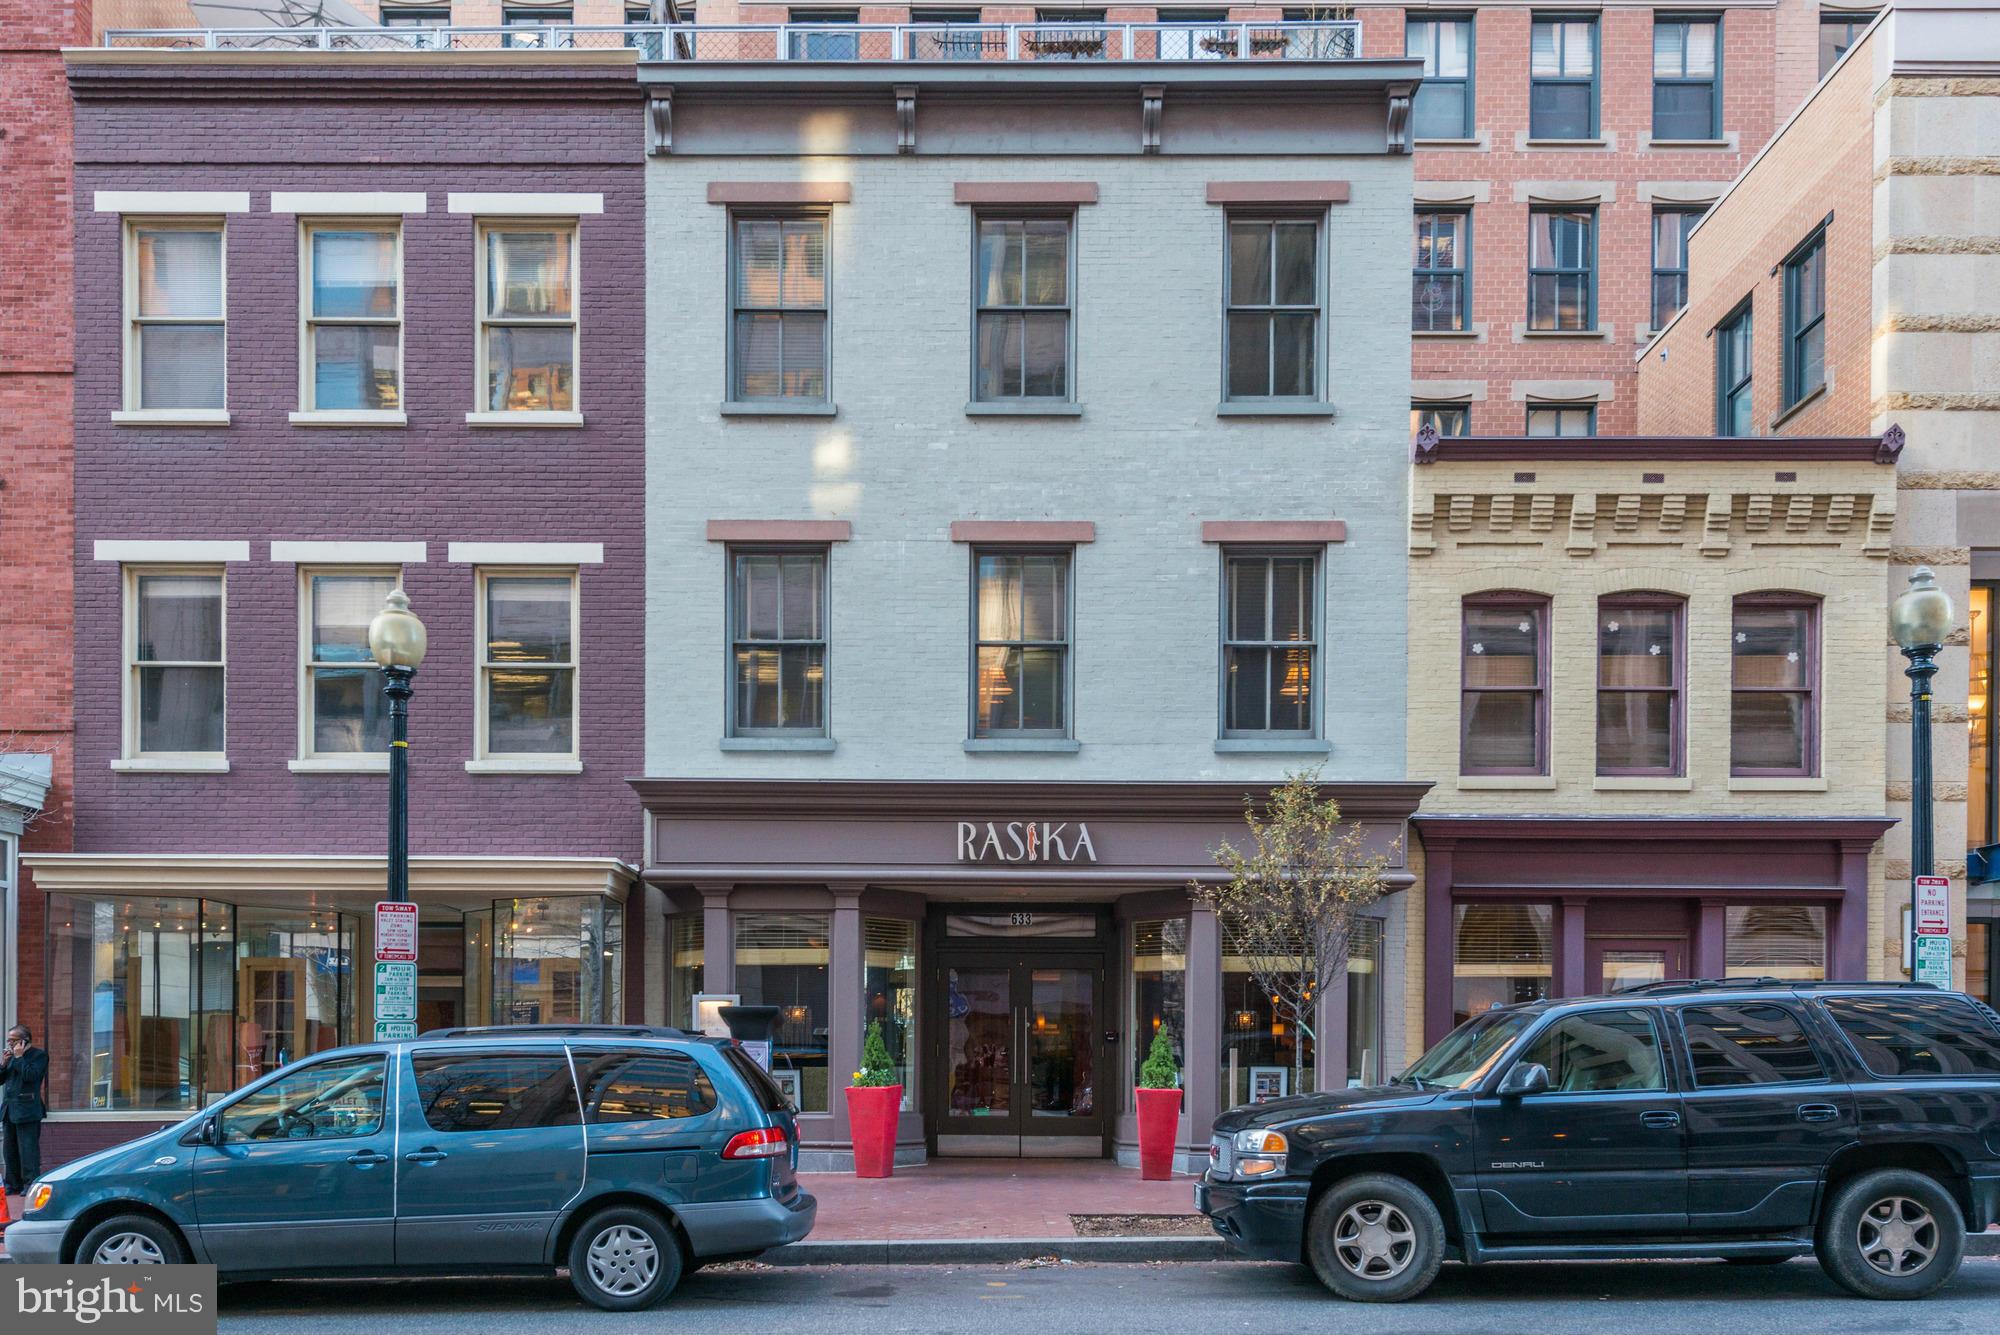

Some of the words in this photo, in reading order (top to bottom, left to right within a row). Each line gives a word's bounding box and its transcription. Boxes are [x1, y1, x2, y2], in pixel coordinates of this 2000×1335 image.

[957, 821, 1097, 862] RASIKA
[1011, 914, 1032, 925] 633
[1491, 1161, 1544, 1169] DENALI
[473, 1221, 545, 1233] SIENNA
